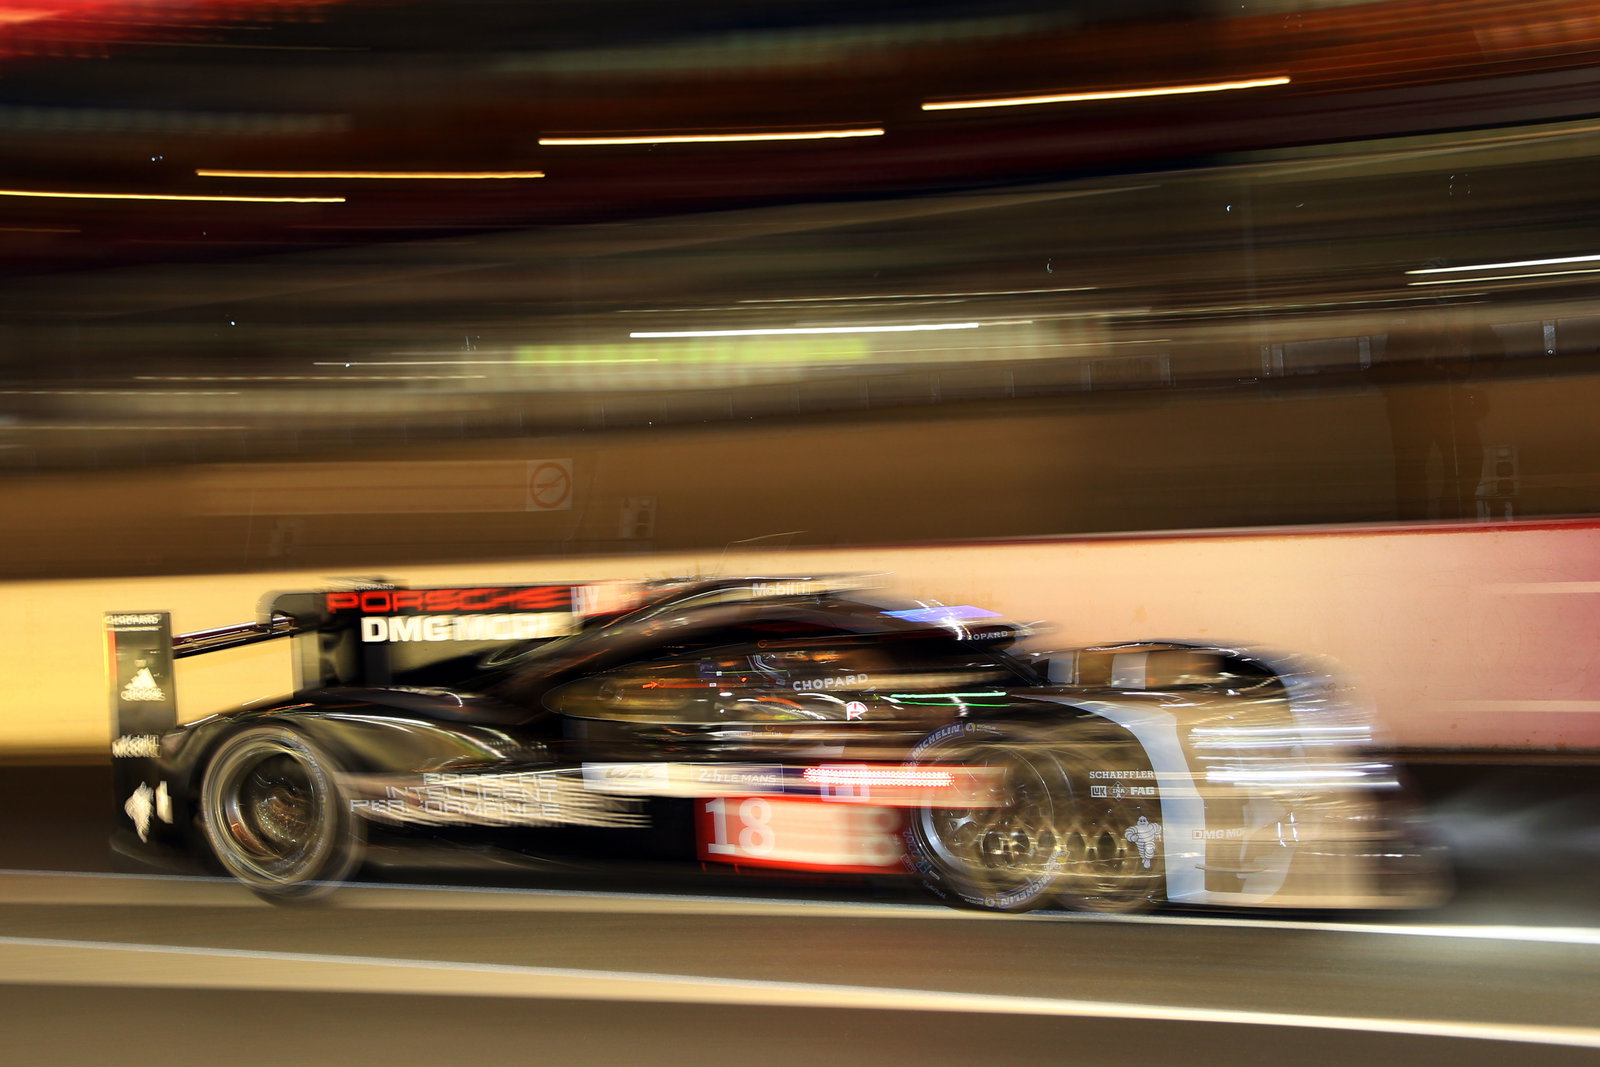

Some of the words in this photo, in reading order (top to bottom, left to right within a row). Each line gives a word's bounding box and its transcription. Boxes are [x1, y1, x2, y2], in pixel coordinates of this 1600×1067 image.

[752, 582, 795, 597] Mobil
[361, 616, 449, 642] DMG
[792, 673, 869, 691] CHOPARD
[911, 723, 962, 759] MICHELIN
[741, 774, 777, 783] MANS
[1089, 770, 1154, 779] SCHAEFFLER
[385, 786, 558, 802] INTELLIGENT
[1130, 786, 1155, 796] FAG
[350, 799, 561, 818] PERORMANCE
[705, 797, 775, 856] 18
